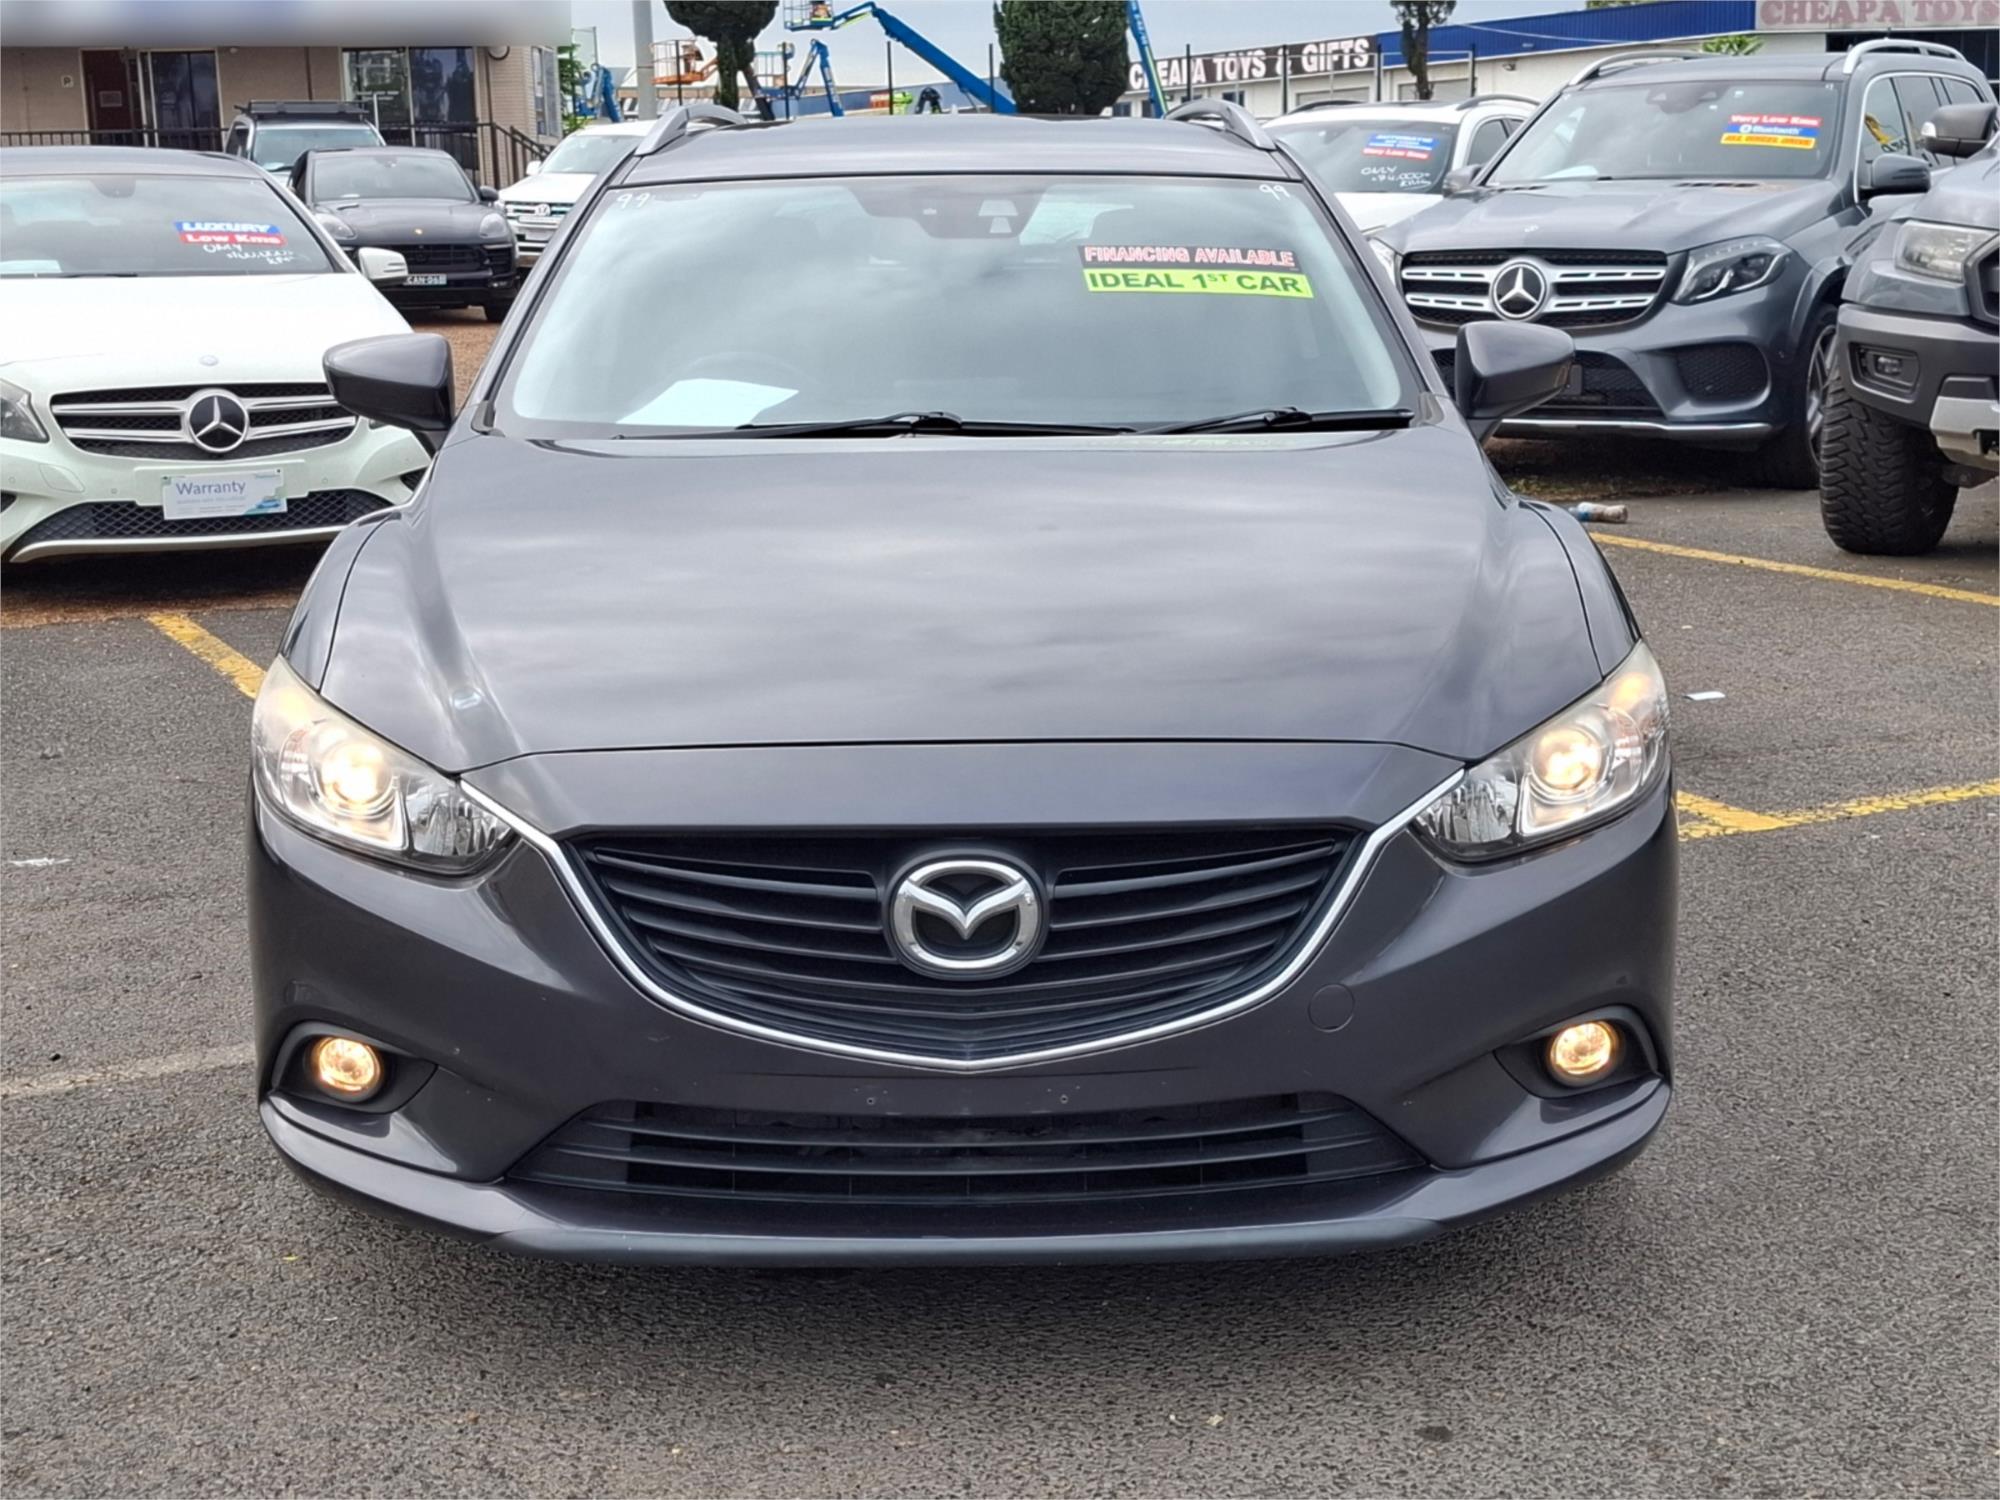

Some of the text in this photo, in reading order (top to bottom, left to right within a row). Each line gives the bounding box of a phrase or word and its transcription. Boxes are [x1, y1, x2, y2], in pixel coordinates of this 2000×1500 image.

[1759, 0, 2000, 25] CHEAPA TOYS
[1212, 50, 1267, 82] TOYS
[1302, 38, 1370, 73] GIFTS
[181, 221, 272, 233] LUXURY
[184, 232, 281, 245] Low Kms
[1084, 247, 1295, 267] FINANCING AVAILABLE
[1088, 273, 1185, 289] IDEAL
[1235, 274, 1304, 293] CAR
[175, 480, 246, 496] Warranty
